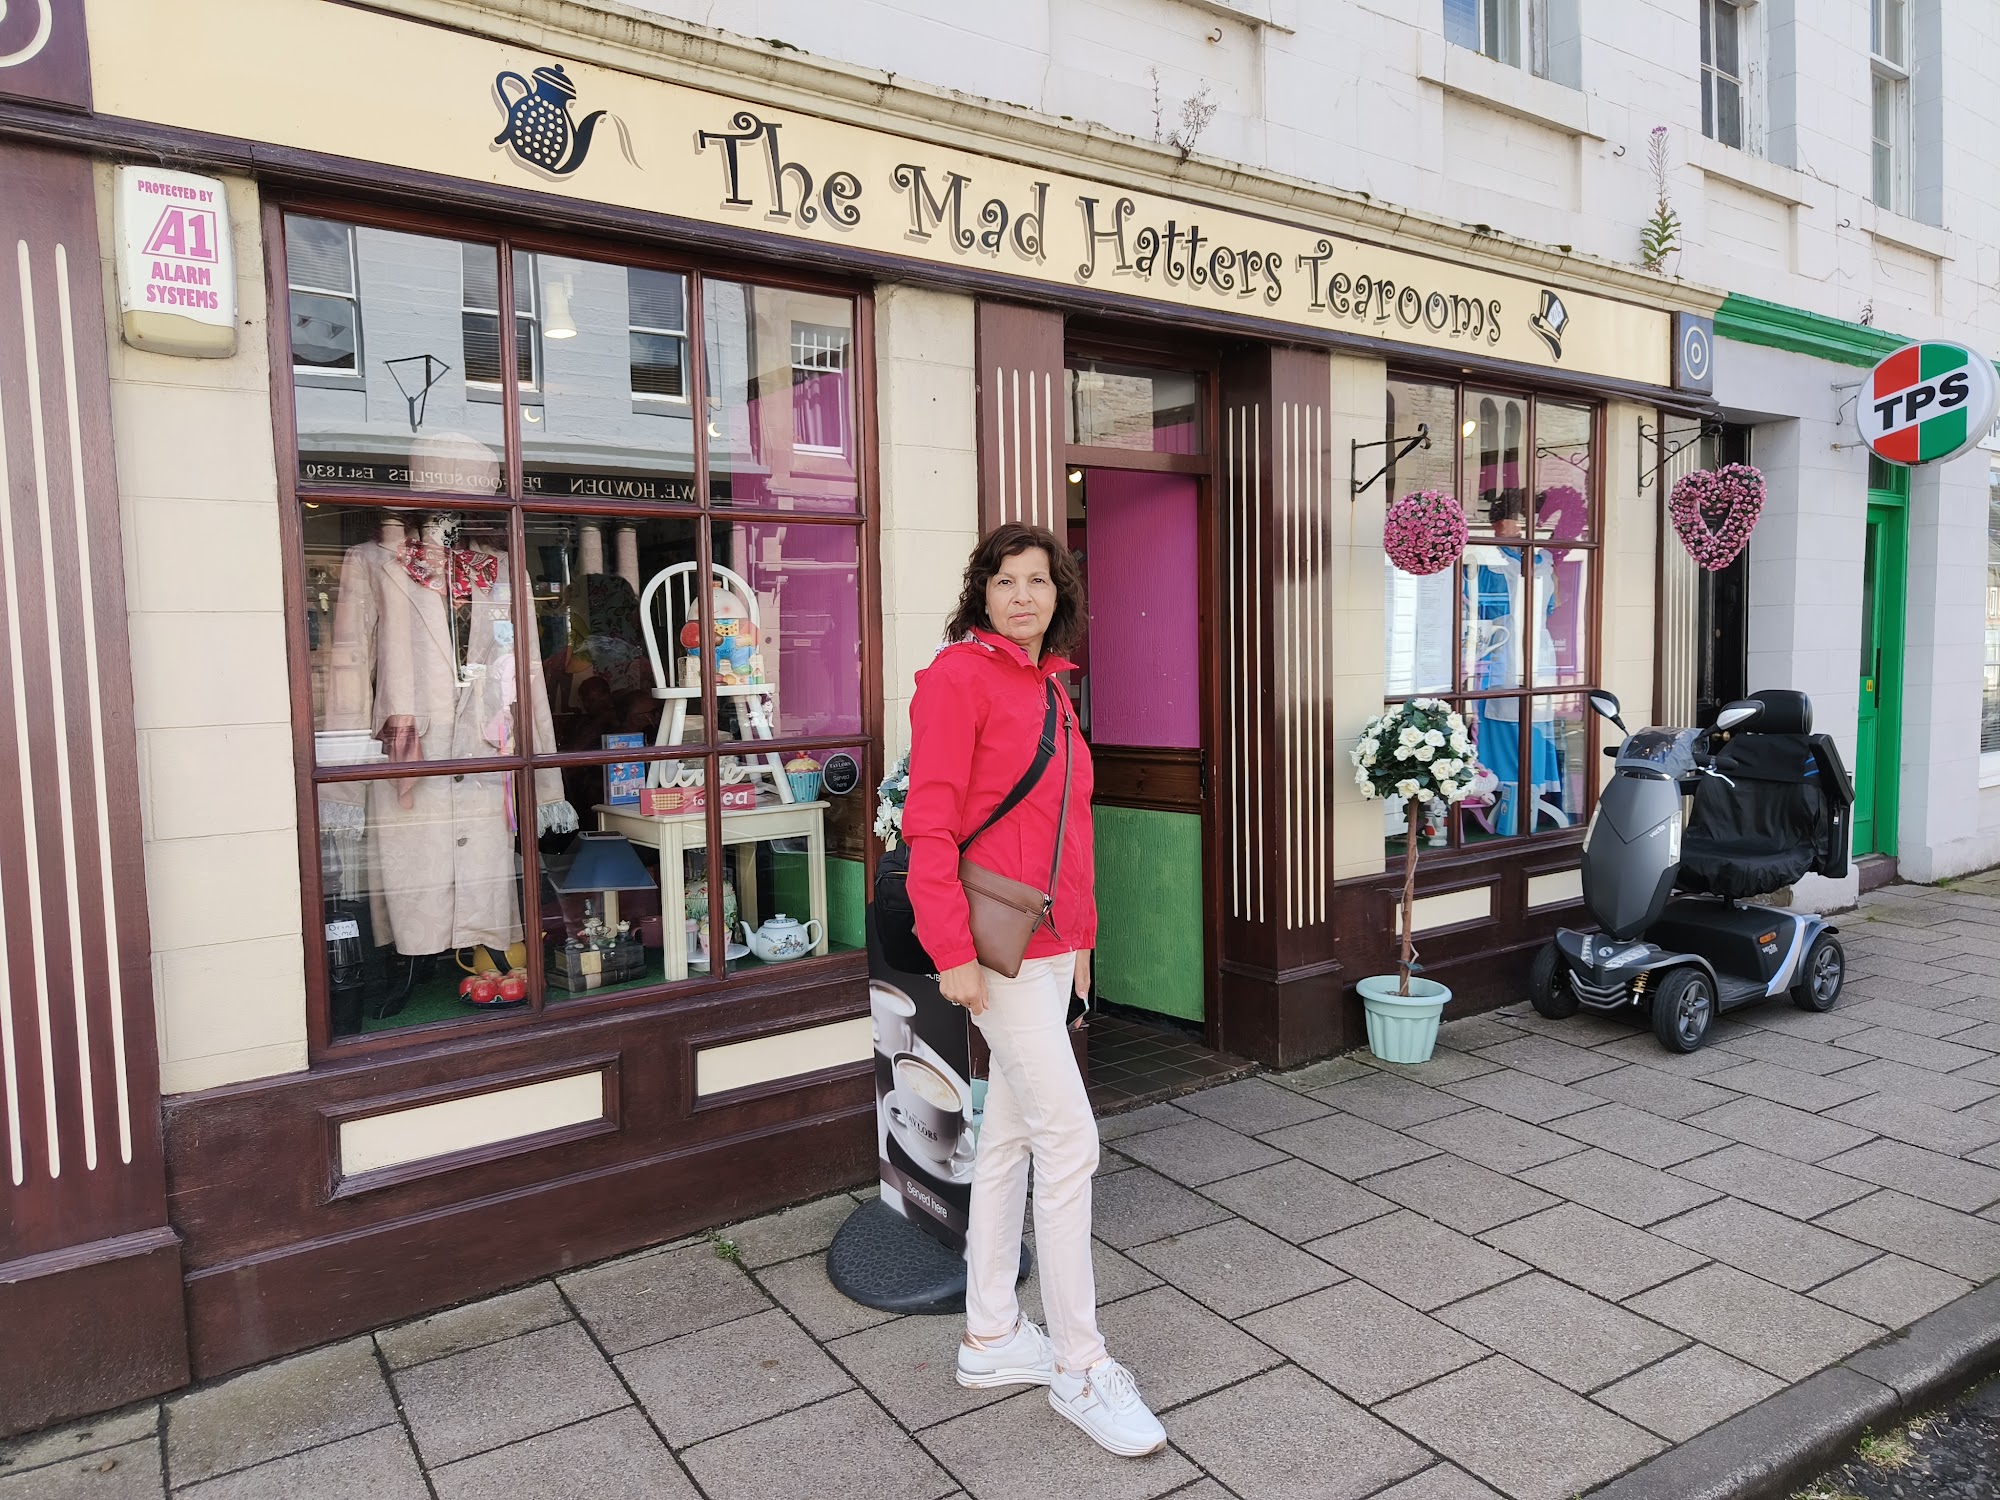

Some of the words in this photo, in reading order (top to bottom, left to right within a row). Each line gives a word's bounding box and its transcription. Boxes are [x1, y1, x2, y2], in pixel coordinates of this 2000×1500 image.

[137, 179, 197, 200] PROTECTED
[199, 190, 213, 202] BY
[151, 210, 212, 258] A1
[698, 111, 862, 226] The
[893, 162, 1047, 261] Mad
[1077, 196, 1282, 301] Hatters
[1299, 239, 1502, 343] Tearooms
[151, 261, 211, 286] ALARM
[146, 284, 218, 309] SYSTEMS
[1874, 372, 1969, 431] TPS
[693, 796, 706, 806] fo
[722, 791, 748, 805] ea
[906, 1180, 931, 1206] Served
[931, 1197, 948, 1218] here
